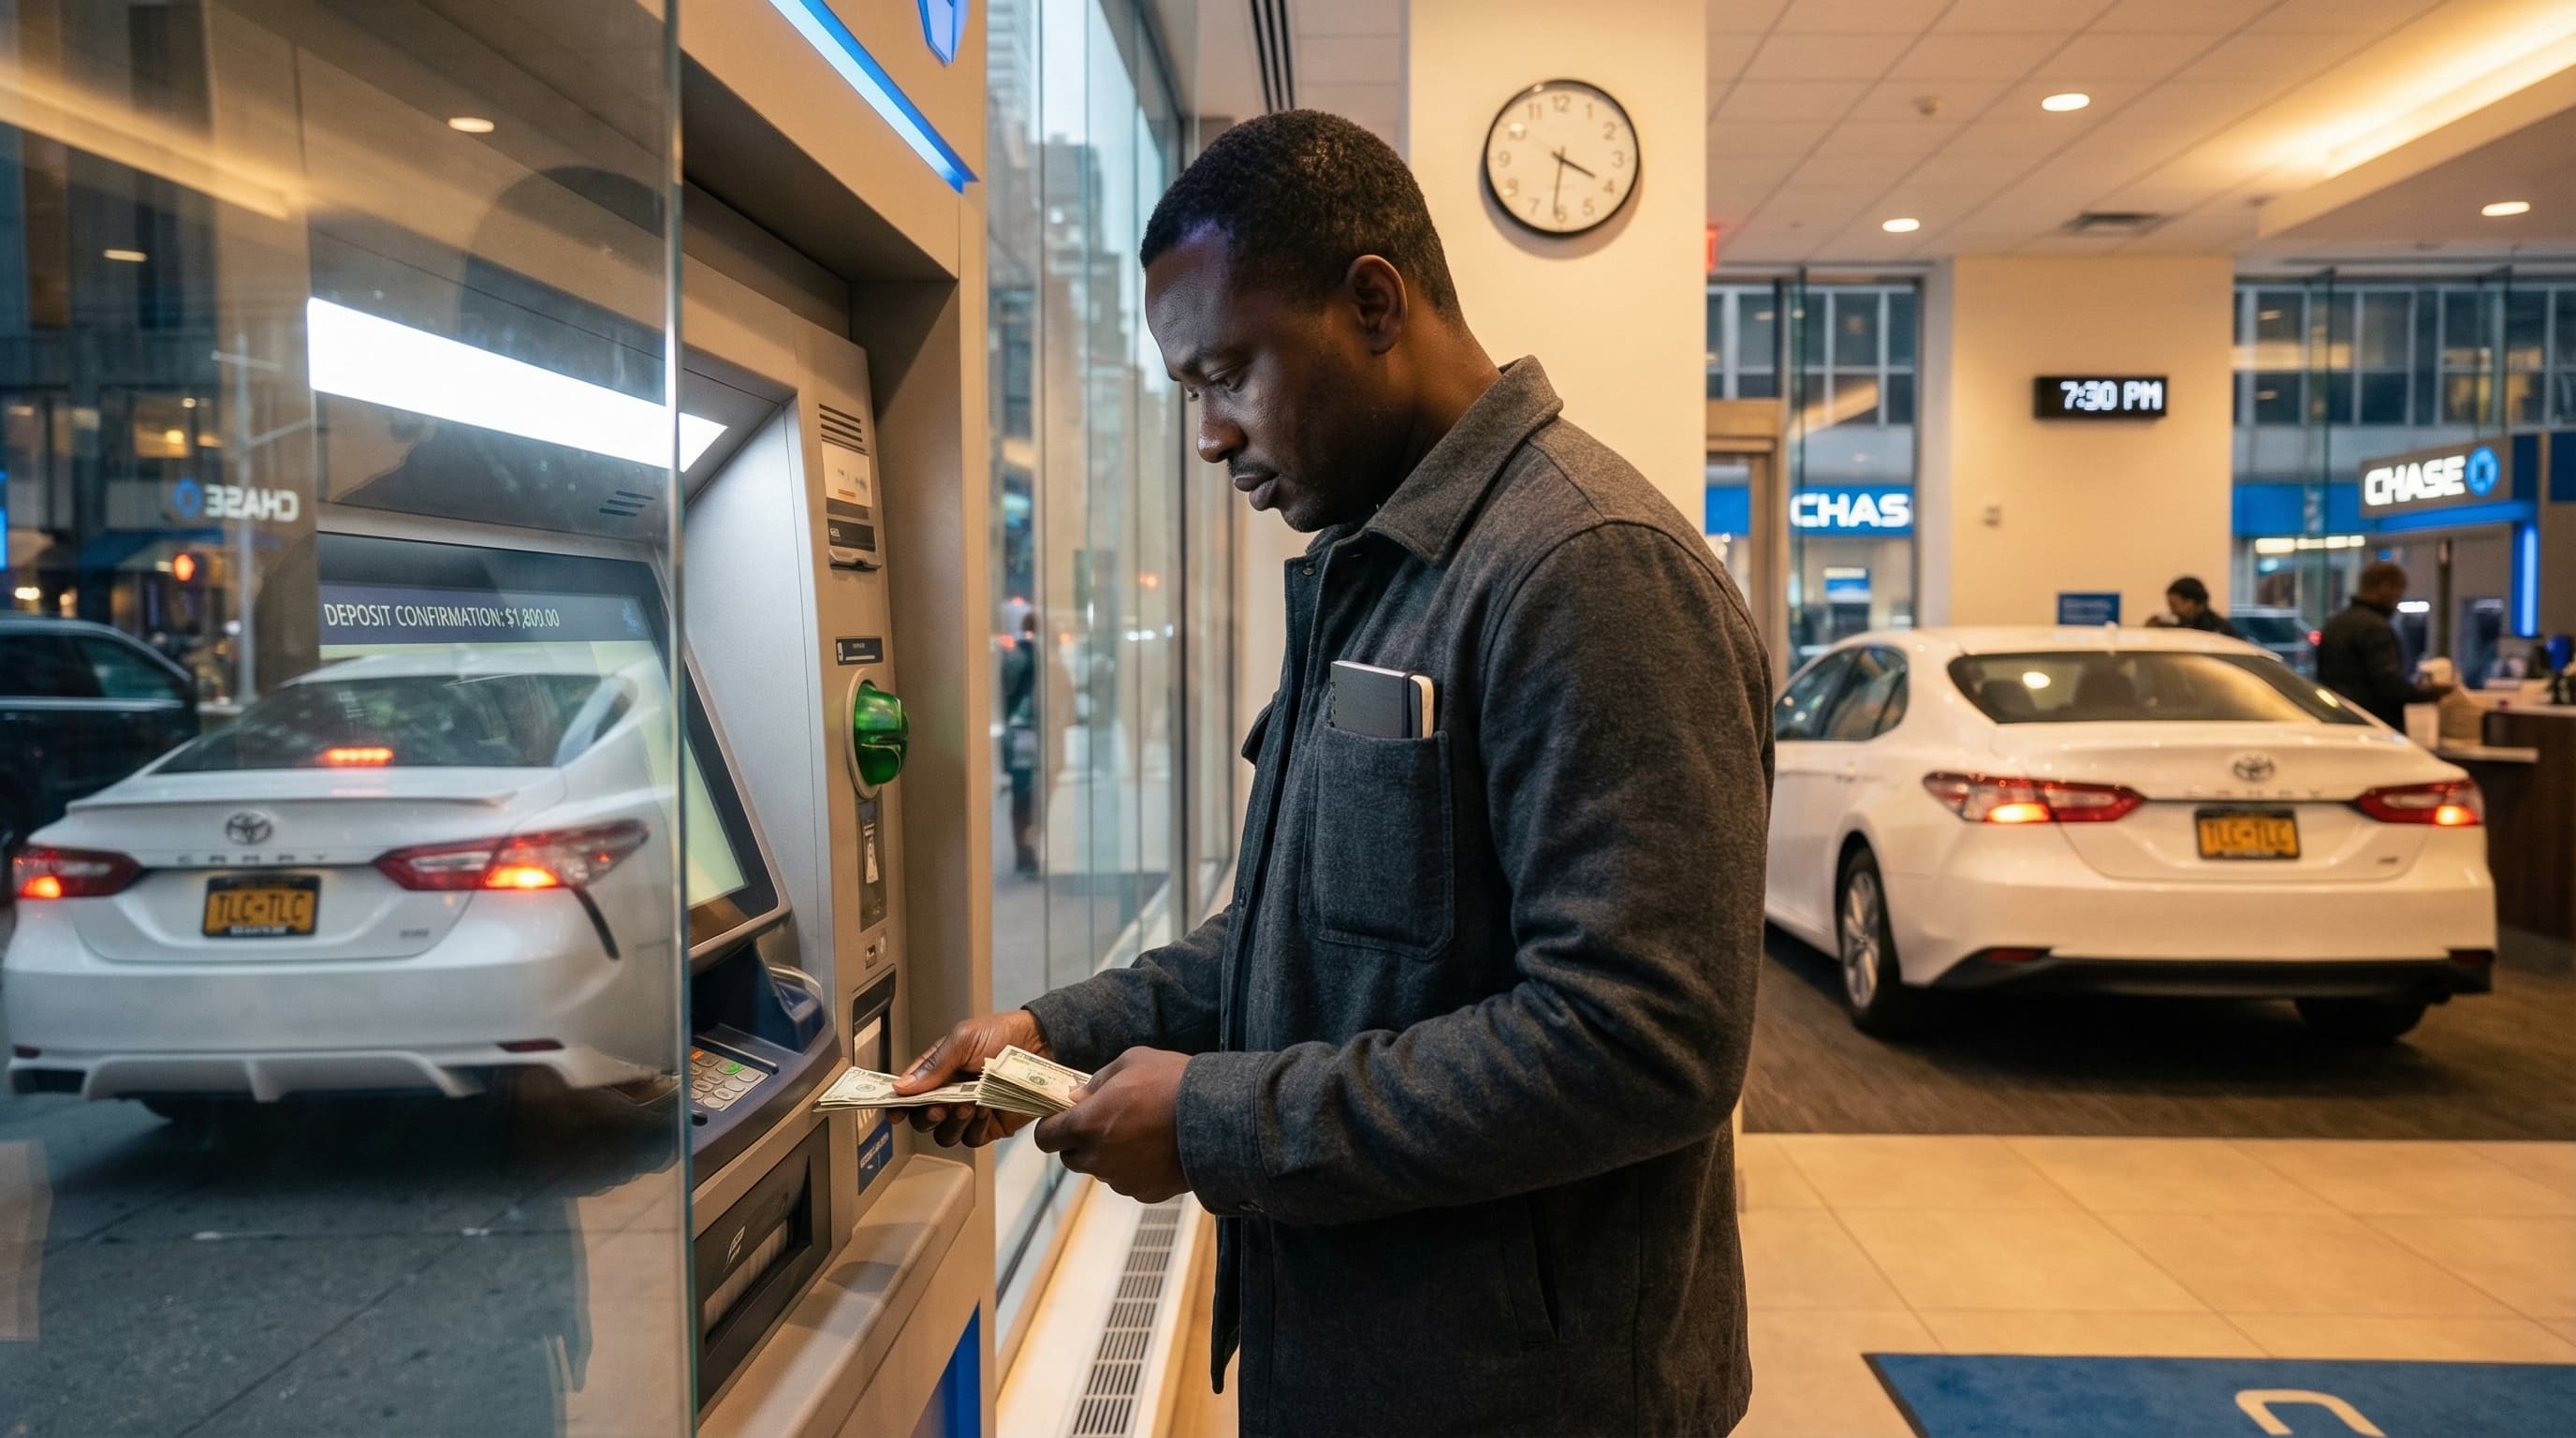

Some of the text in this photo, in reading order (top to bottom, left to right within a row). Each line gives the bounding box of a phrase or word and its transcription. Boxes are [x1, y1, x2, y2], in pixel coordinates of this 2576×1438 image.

[1528, 103, 1543, 120] 11
[1552, 95, 1571, 112] 12
[1586, 103, 1593, 120] 1
[1603, 122, 1617, 140] 2
[1498, 151, 1512, 168] 9
[1612, 150, 1625, 169] 3
[1603, 179, 1615, 194] 4
[1528, 198, 1541, 215] 7
[1555, 203, 1567, 223] 6
[1582, 198, 1595, 216] 5
[2060, 380, 2163, 411] 7:30 PM
[2364, 454, 2466, 506] CHASE
[1790, 492, 1913, 528] CHAS
[323, 604, 391, 626] DEPOSIT
[395, 605, 505, 627] CONFIRMATION:
